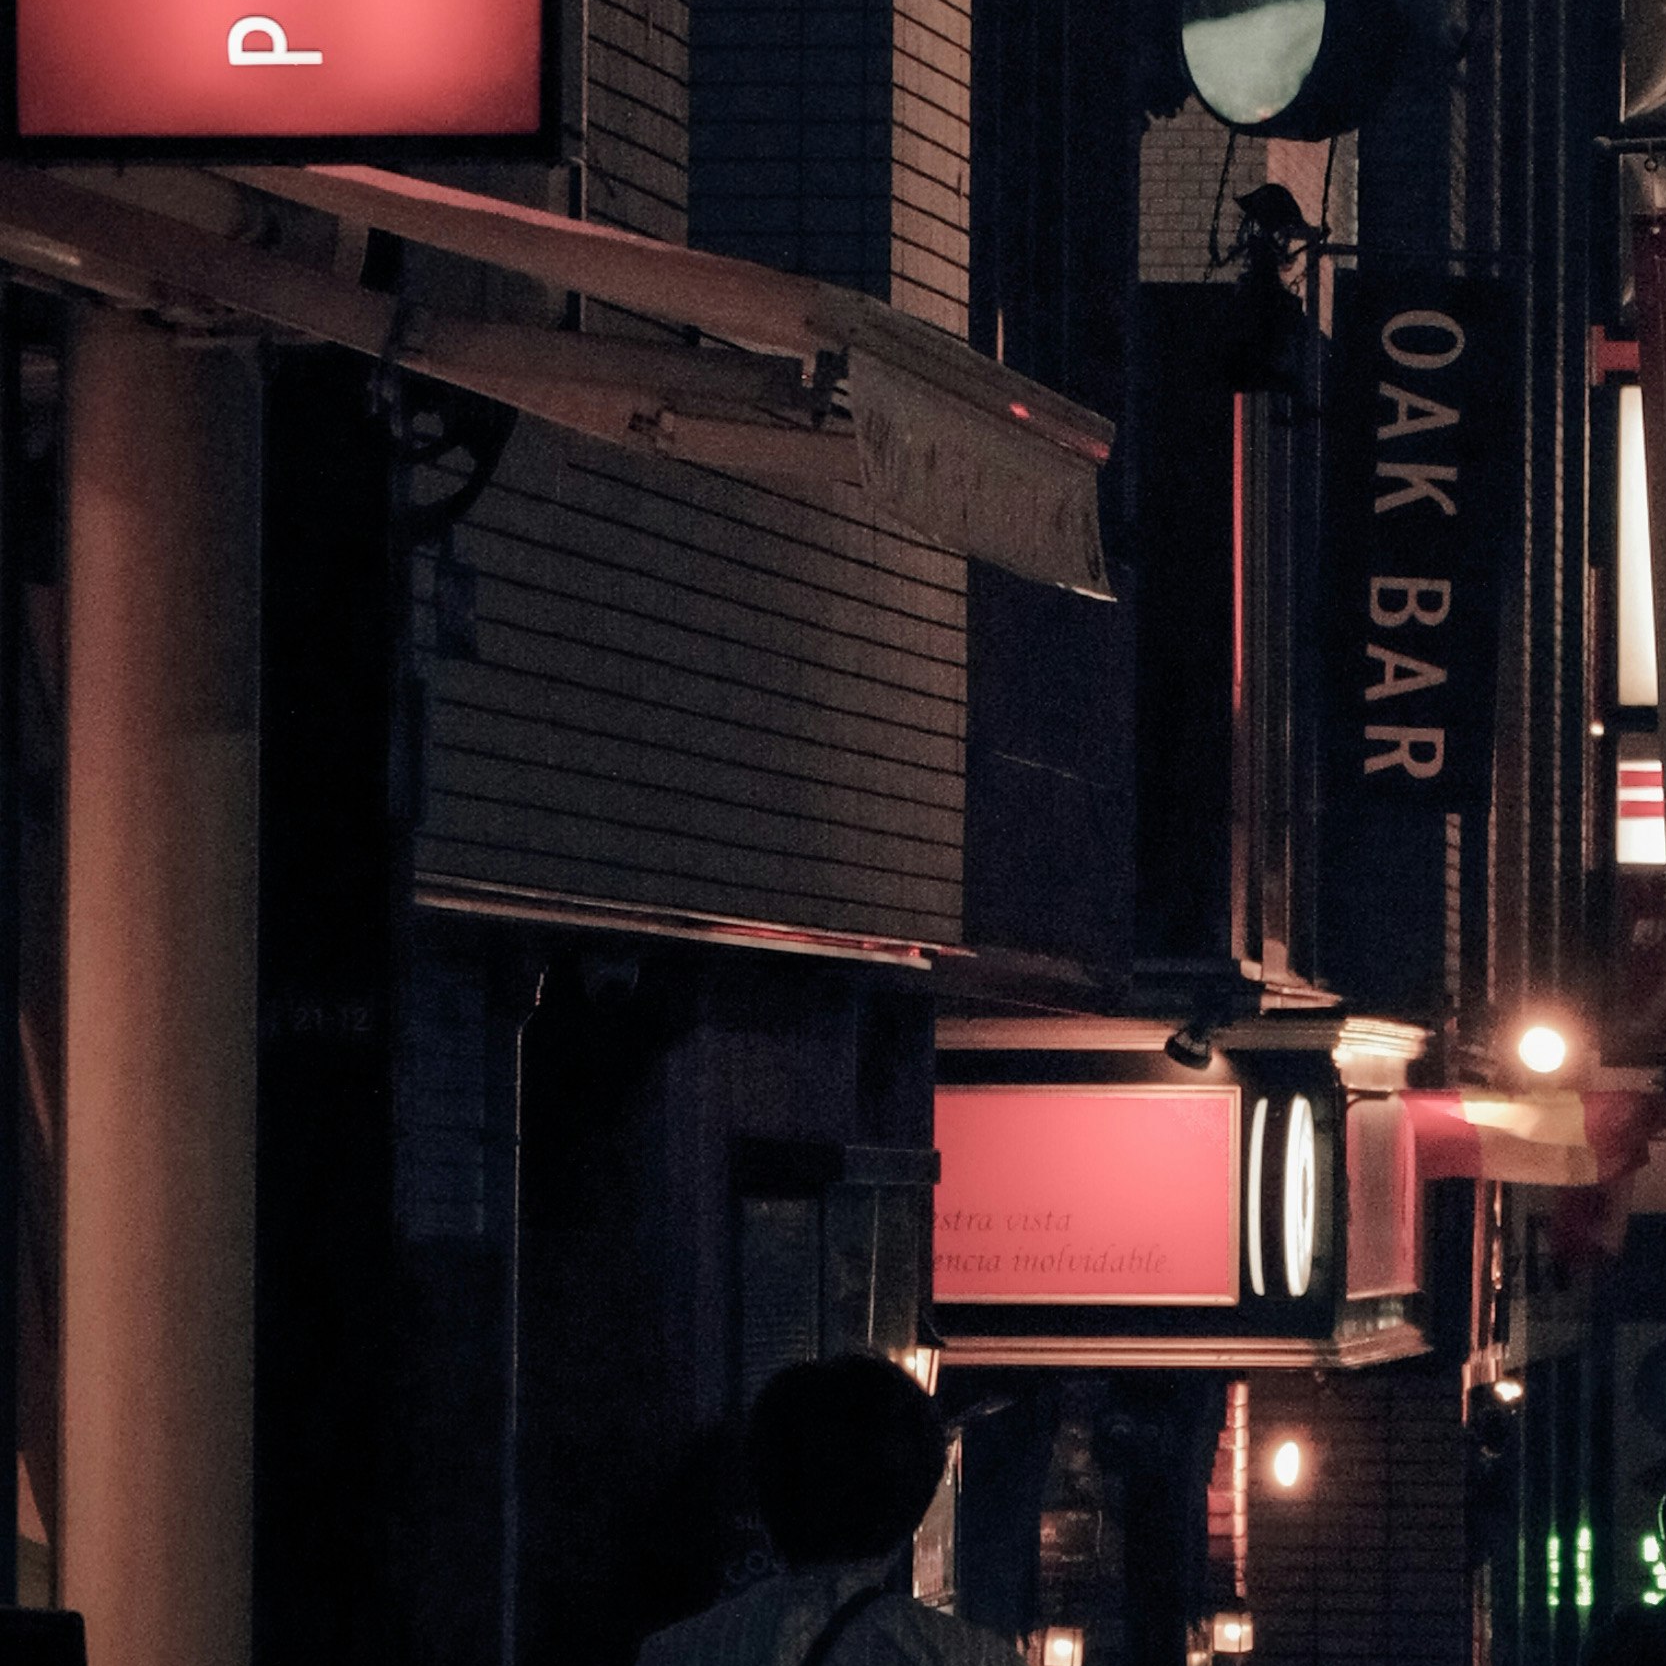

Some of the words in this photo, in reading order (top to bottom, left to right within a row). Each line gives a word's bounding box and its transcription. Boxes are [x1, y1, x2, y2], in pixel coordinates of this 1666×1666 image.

[1373, 309, 1466, 517] OAK
[1363, 575, 1453, 780] BAR
[936, 1210, 993, 1231] stra
[1006, 1210, 1072, 1232] vista
